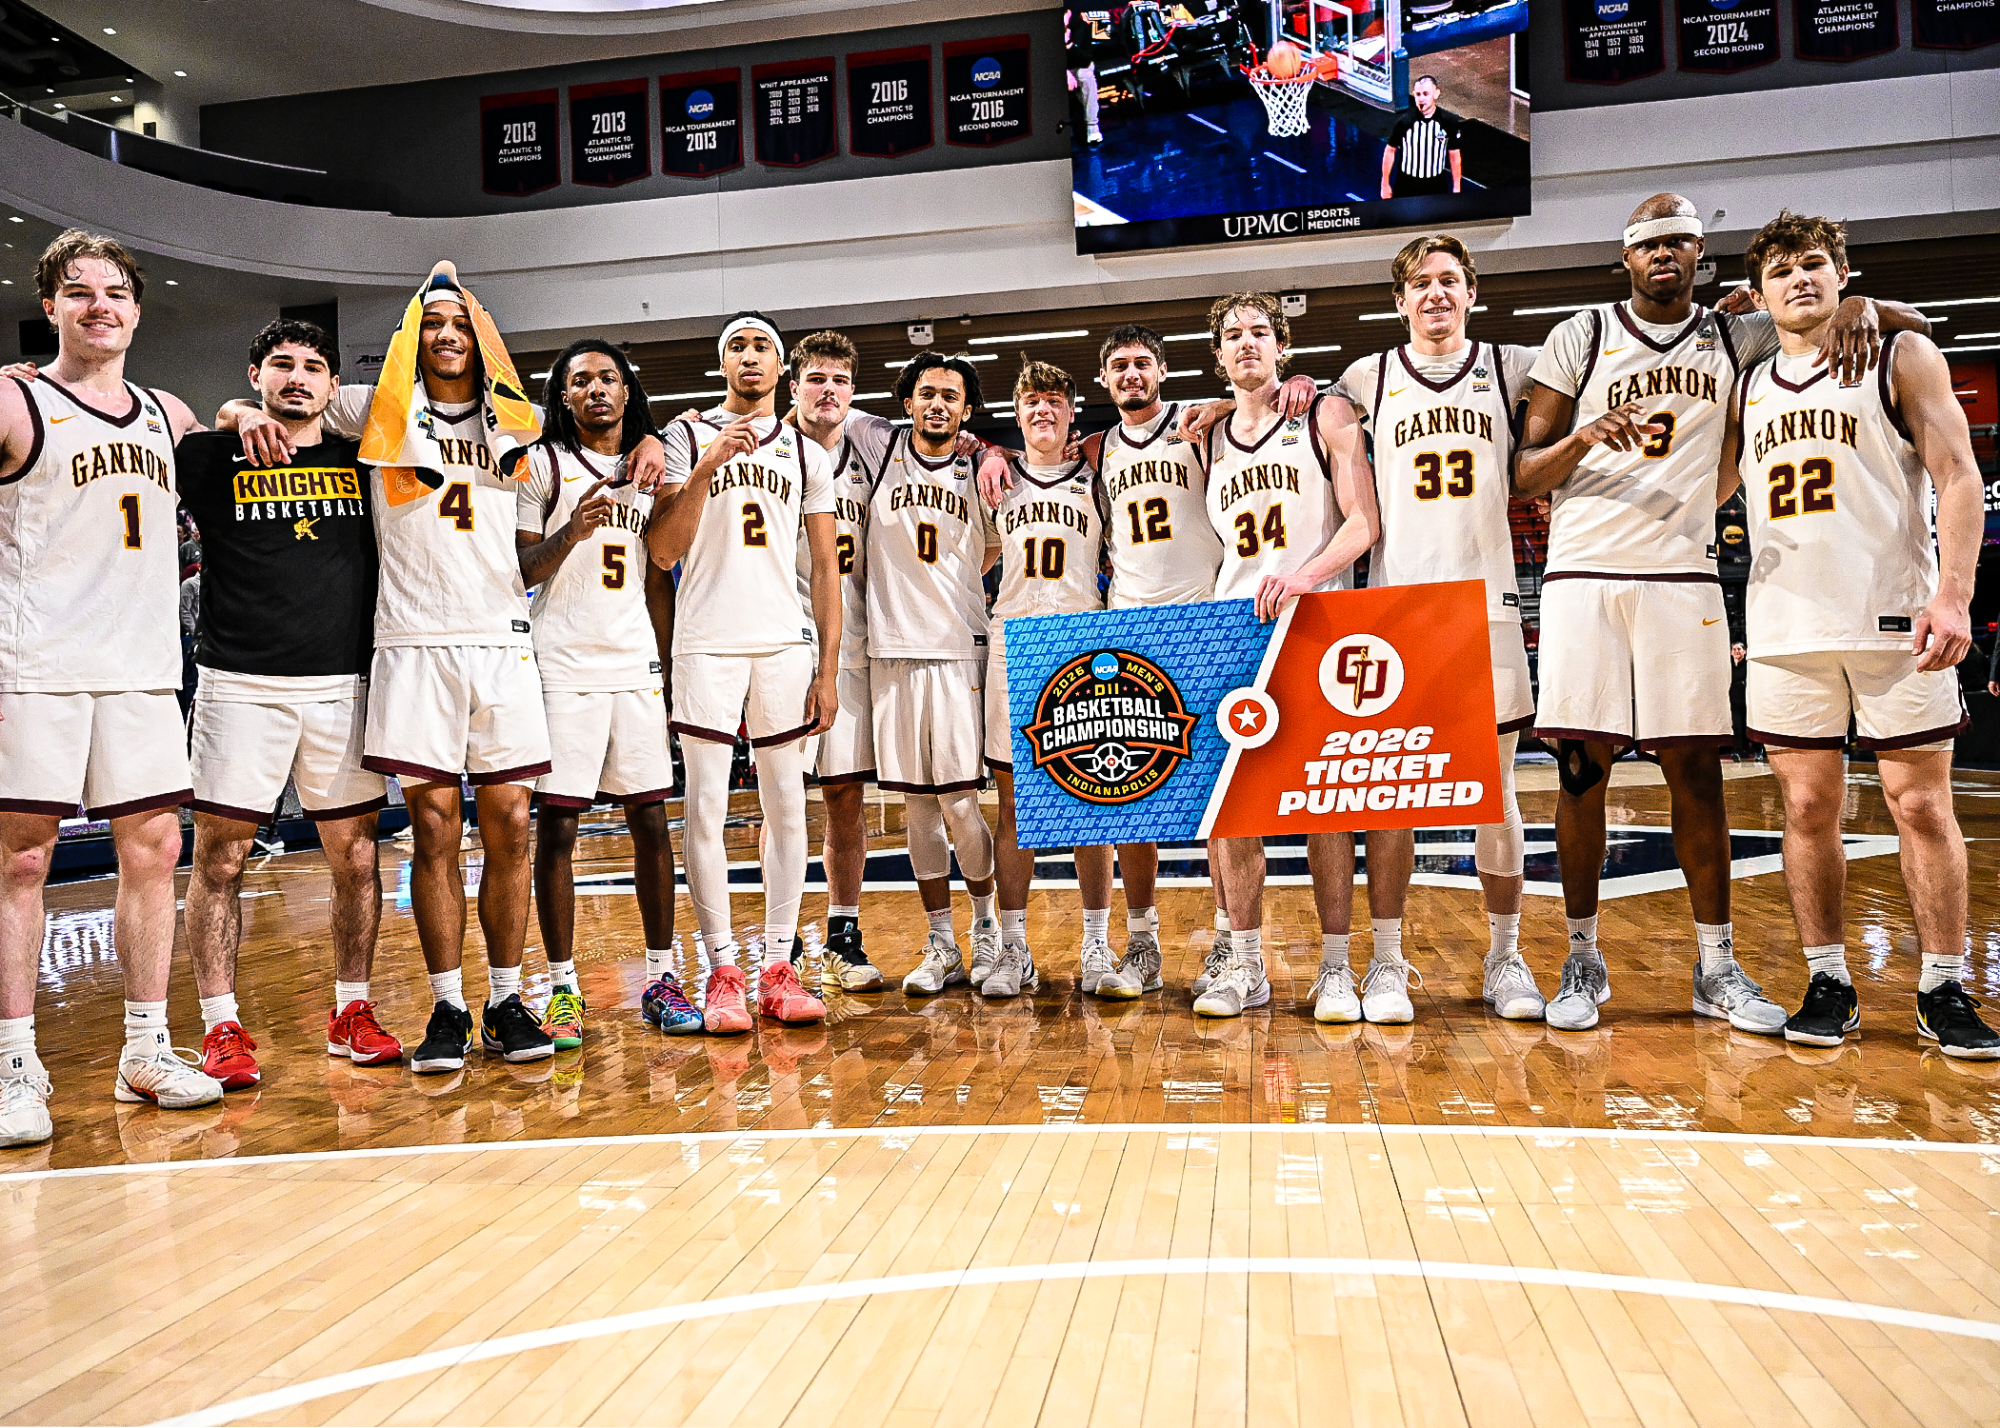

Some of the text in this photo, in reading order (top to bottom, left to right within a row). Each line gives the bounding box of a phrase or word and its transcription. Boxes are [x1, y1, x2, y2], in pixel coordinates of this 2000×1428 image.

[1598, 3, 1628, 14] NCAA
[1683, 9, 1770, 24] NCAA TOURNAMENT
[1818, 4, 1862, 15] ATLANTIC
[1937, 0, 1995, 12] CHAMPIONS
[1600, 21, 1647, 31] TOURNAMENT
[1814, 11, 1878, 25] TOURNAMENT
[1818, 22, 1875, 34] CHAMPIONS
[1589, 28, 1638, 38] APPEARANCES
[1707, 22, 1749, 45] 2024
[1628, 45, 1644, 54] 2024
[1694, 43, 1764, 57] SECOND ROUND
[780, 76, 828, 87] APPEARANCES
[974, 71, 1001, 81] NCAA
[871, 79, 908, 104] 2016
[950, 88, 1024, 102] NCAA TOURNAMENT
[688, 103, 714, 113] NCAA
[867, 104, 913, 115] ATLANTIC 10
[867, 112, 913, 124] CHAMPIONS
[972, 100, 1004, 121] 2016
[503, 121, 536, 144] 2013
[592, 111, 626, 134] 2013
[665, 120, 736, 133] NCAA TOURNAMENT
[959, 120, 1018, 132] SECOND ROUND
[499, 146, 532, 155] ATLANTIC
[584, 144, 634, 154] TOURNAMENT
[587, 137, 621, 146] ATLANTIC
[686, 131, 717, 152] 2013
[498, 154, 541, 163] CHAMPIONS
[587, 152, 632, 162] CHAMPIONS
[1223, 212, 1298, 237] UPMC
[1307, 207, 1350, 219] SPORTS
[1307, 217, 1360, 230] MEDICINE
[1607, 366, 1717, 410] GANNON
[1394, 405, 1494, 448] GANNON
[1642, 411, 1676, 458] 3
[1753, 408, 1858, 464] GANNON
[71, 441, 171, 493] GANNON
[1413, 448, 1475, 501] 33
[237, 471, 357, 498] KNIGHTS
[709, 462, 792, 505] GANNON
[1108, 460, 1190, 501] GANNON
[1220, 462, 1301, 512] GANNON
[1768, 456, 1836, 521] 22
[438, 480, 475, 532] 4
[890, 485, 969, 525] GANNON
[119, 493, 142, 550] 1
[741, 501, 768, 548] 2
[1005, 501, 1088, 538] GANNON
[1127, 496, 1173, 545] 12
[1234, 502, 1287, 559] 34
[916, 520, 939, 565] 0
[601, 543, 627, 591] 5
[1023, 536, 1066, 581] 10
[1053, 662, 1164, 698] 2026 MEN'S
[1094, 666, 1118, 674] NCAA
[1094, 683, 1119, 696] DII
[1053, 698, 1164, 726] BASKETBALL
[1042, 719, 1179, 750] CHAMPIONSHIP
[1319, 726, 1434, 756] 2026
[1304, 753, 1451, 785] TICKET
[1066, 769, 1158, 795] INDIANAPOLIS
[1277, 781, 1484, 816] PUNCHED
